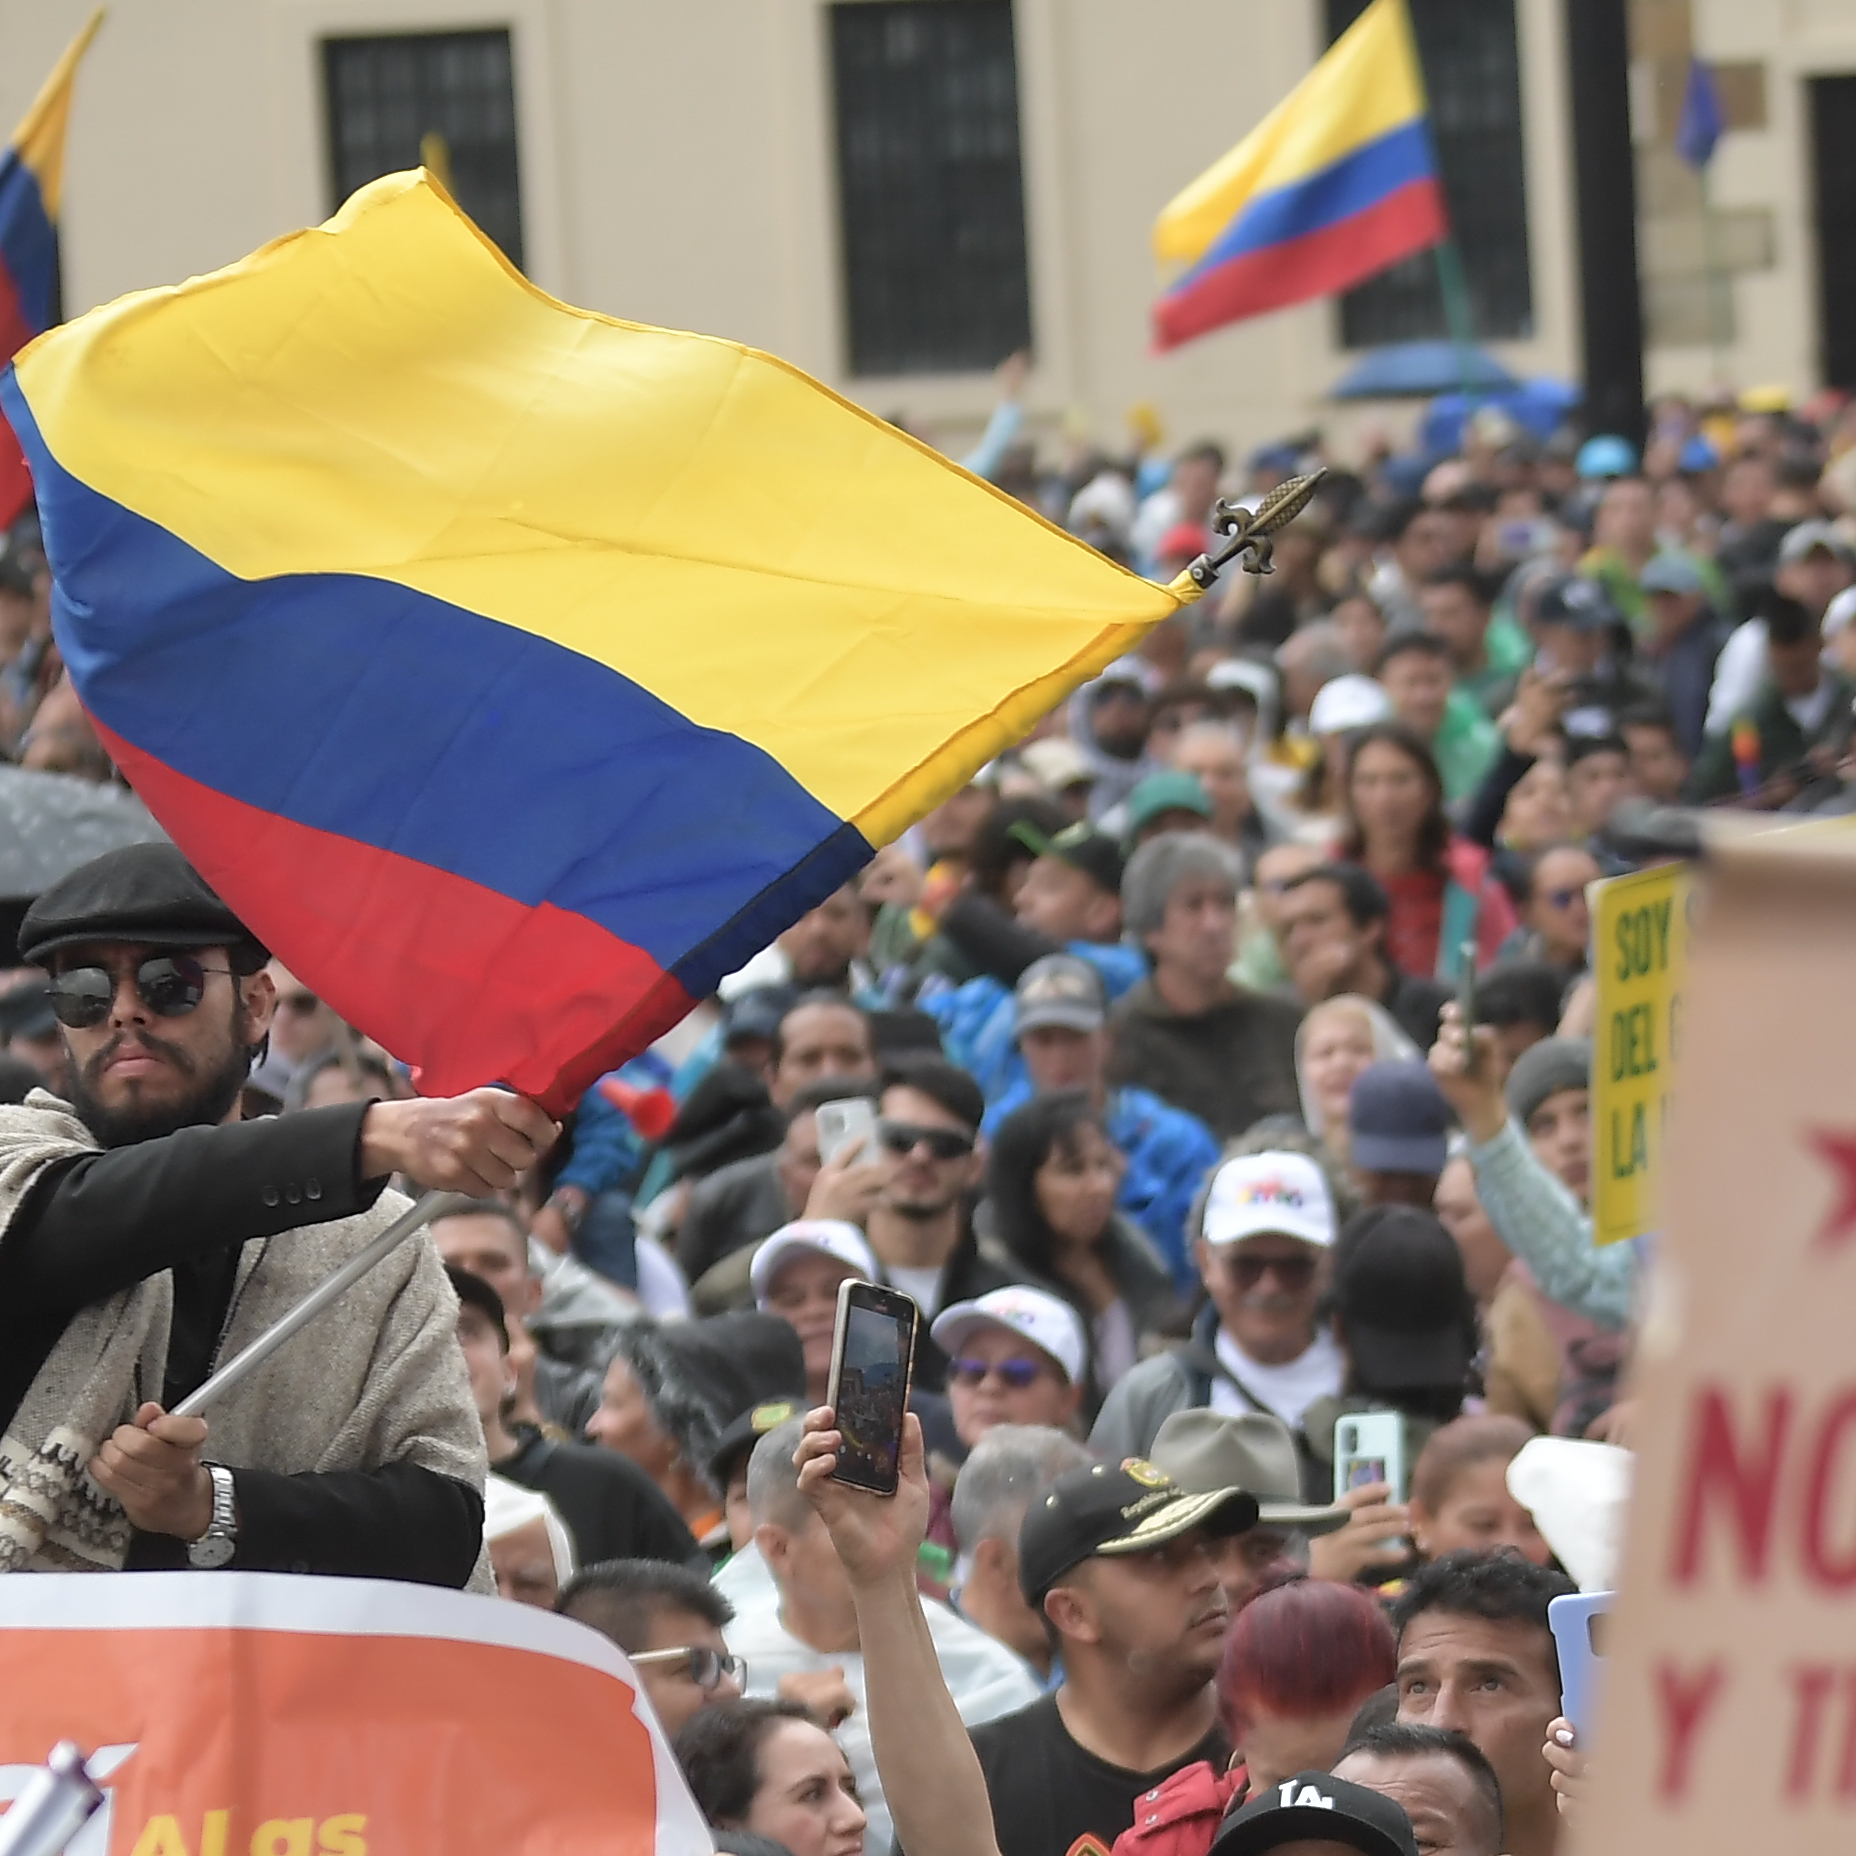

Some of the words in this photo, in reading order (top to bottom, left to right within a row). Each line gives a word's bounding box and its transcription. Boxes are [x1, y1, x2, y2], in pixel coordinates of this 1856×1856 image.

[1614, 897, 1674, 984] SOY
[1611, 1002, 1658, 1082] DEL
[1652, 1667, 1719, 1803] Y
